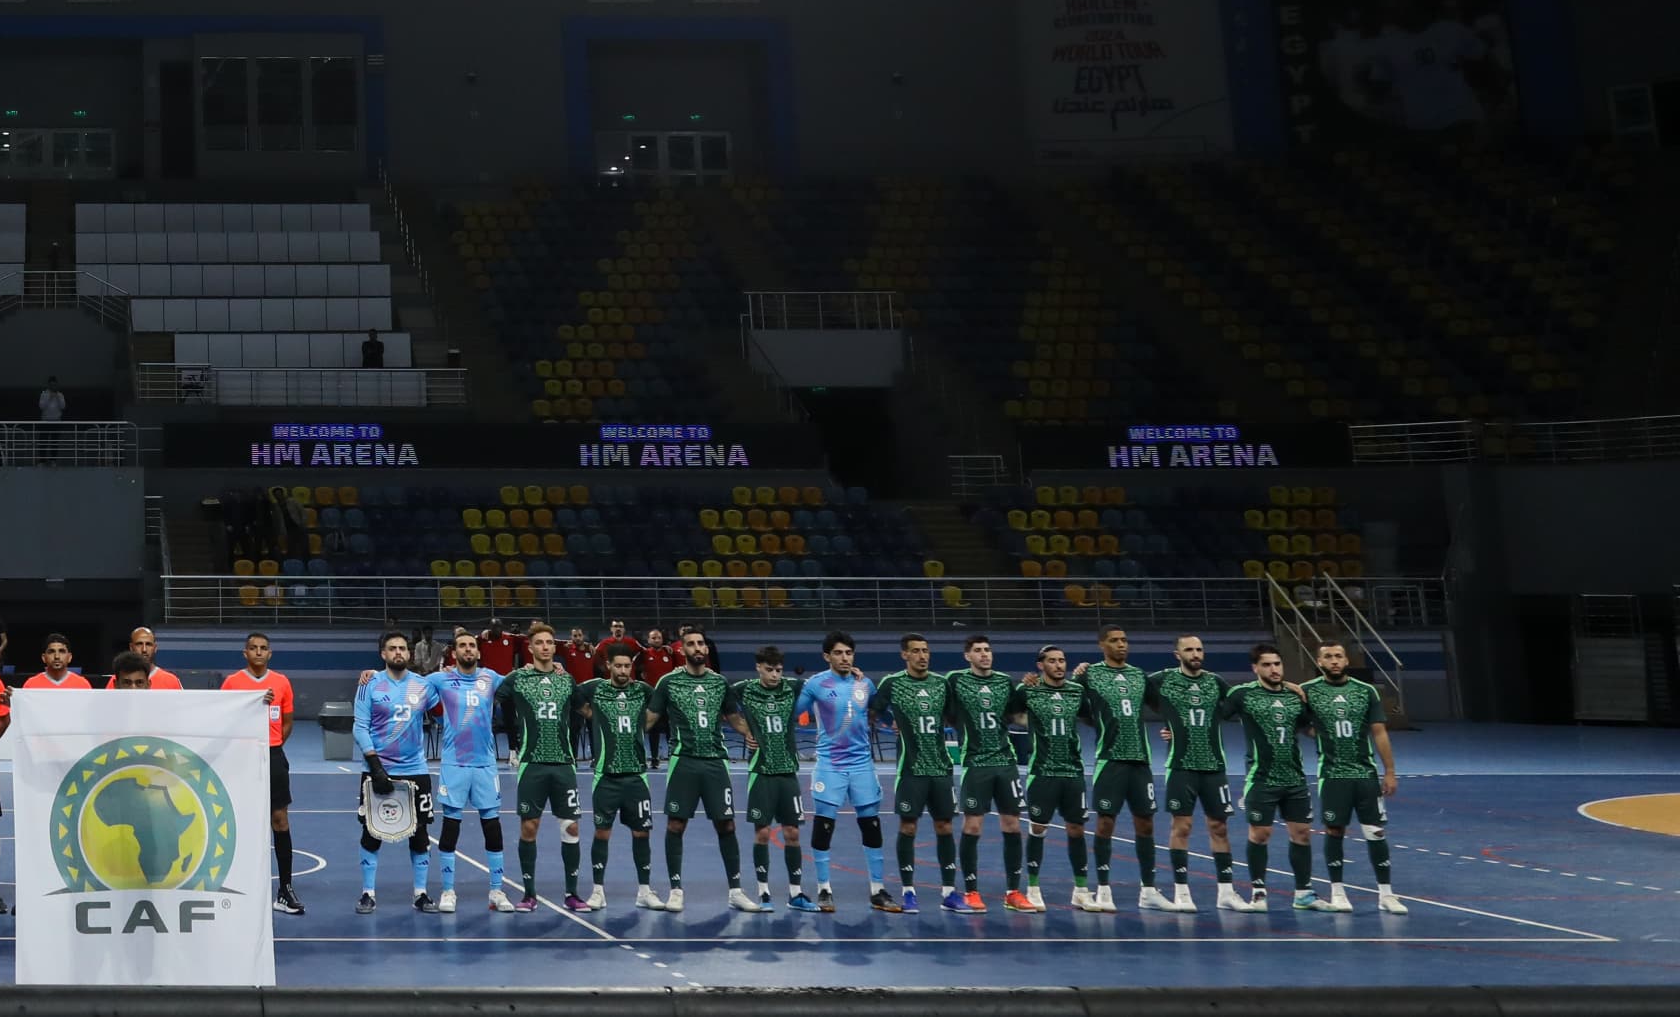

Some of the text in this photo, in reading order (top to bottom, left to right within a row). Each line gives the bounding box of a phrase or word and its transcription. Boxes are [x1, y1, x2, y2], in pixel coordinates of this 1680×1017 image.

[1073, 63, 1147, 95] EGYPT
[274, 426, 381, 438] WELCOME TO
[601, 427, 710, 439] WELCOME TO
[1129, 428, 1237, 440] WELCOME TO
[251, 444, 420, 466] HM ARENA
[579, 445, 750, 467] HM ARENA
[1108, 445, 1279, 468] HM ARENA
[466, 689, 480, 708] 16
[1120, 699, 1132, 717] 8
[393, 703, 411, 722] 23
[537, 701, 558, 720] 22
[697, 710, 708, 729] 6
[1189, 708, 1206, 727] 17
[618, 715, 632, 734] 19
[765, 715, 783, 733] 18
[918, 715, 936, 734] 12
[979, 711, 997, 730] 15
[1050, 717, 1065, 736] 11
[1334, 720, 1353, 738] 10
[1276, 726, 1287, 744] 7
[75, 899, 216, 935] CAF
